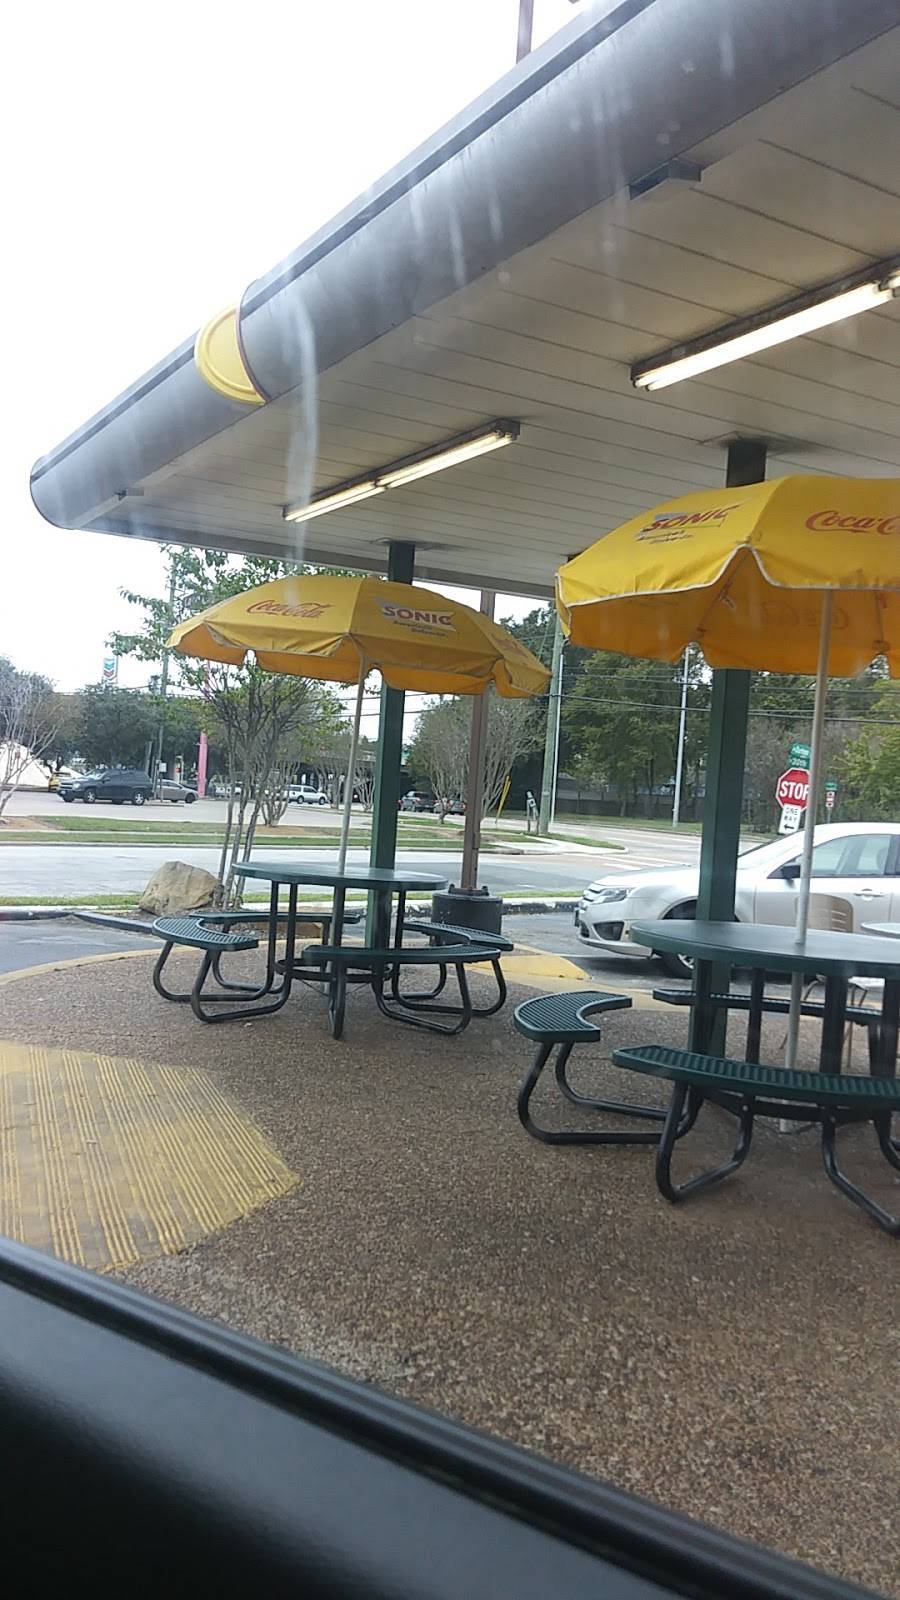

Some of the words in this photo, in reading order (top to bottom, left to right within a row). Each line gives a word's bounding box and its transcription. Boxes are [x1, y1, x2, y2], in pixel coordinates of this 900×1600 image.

[641, 504, 740, 532] SONIC
[246, 599, 334, 617] Coca-Cola
[383, 605, 456, 625] SONIC
[784, 814, 798, 822] WAY
[785, 806, 798, 815] ONE
